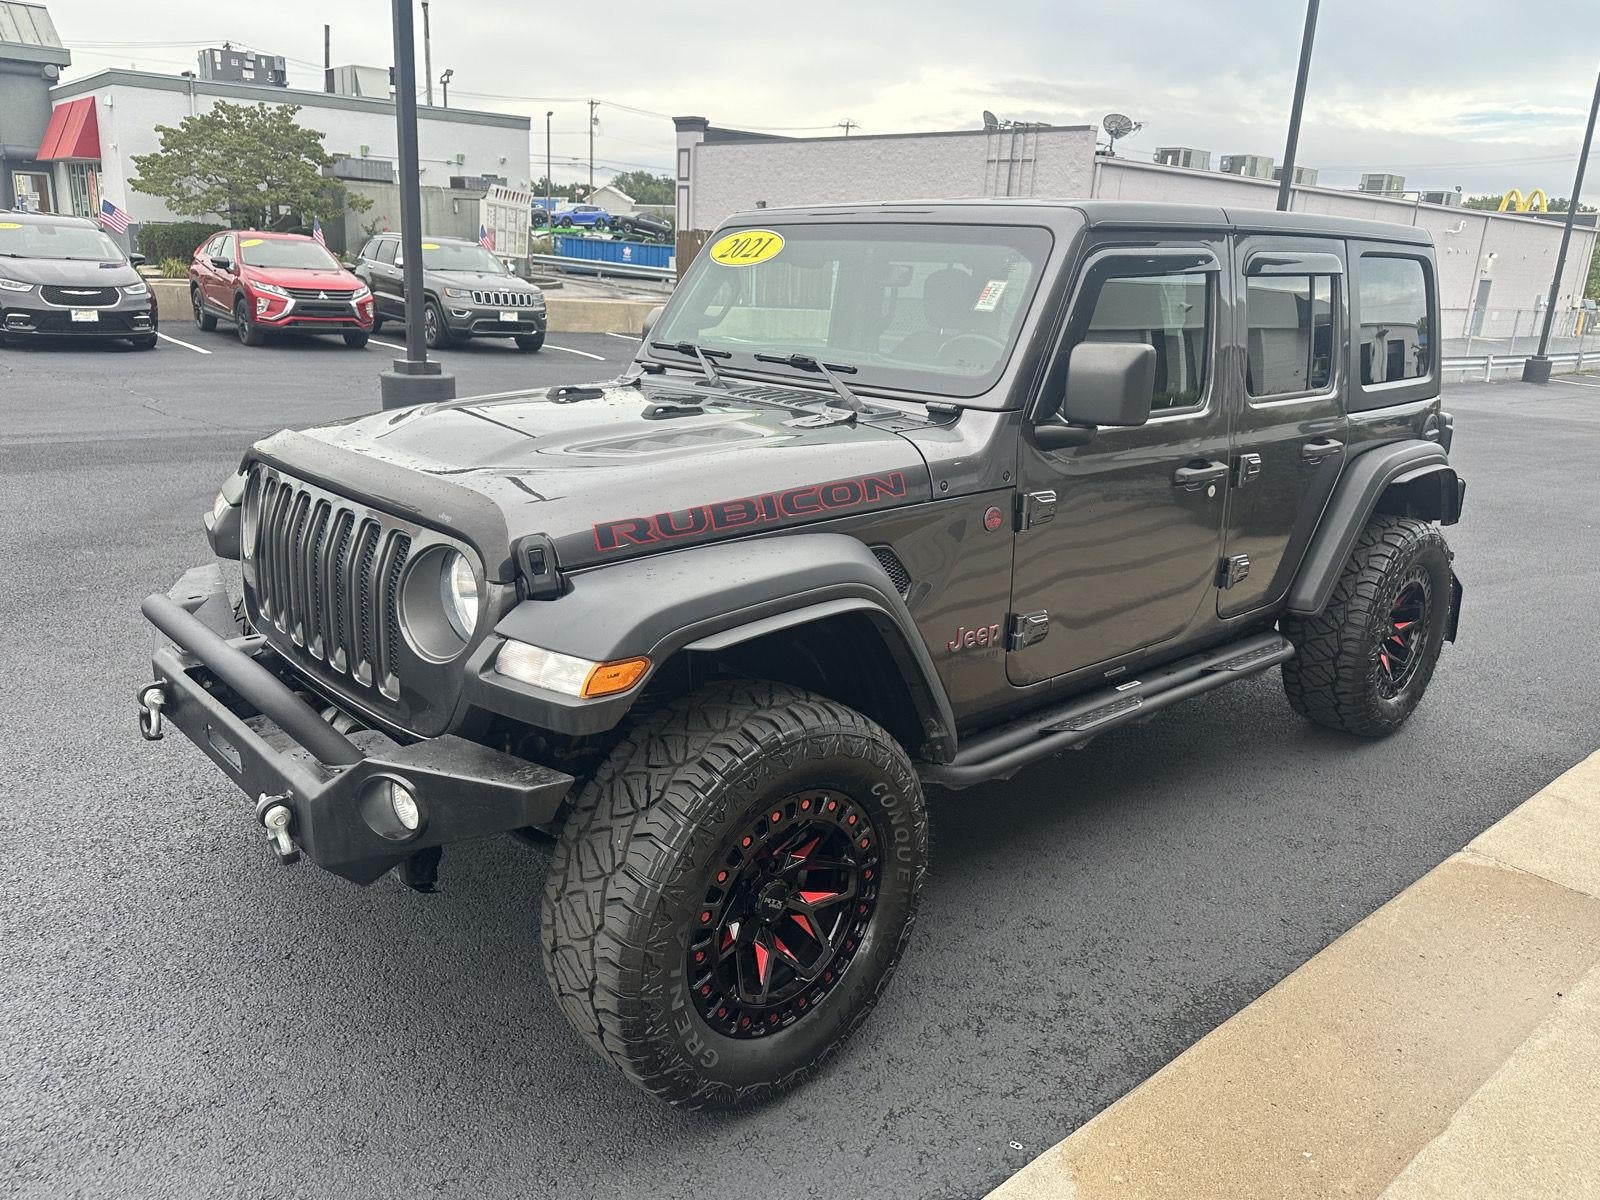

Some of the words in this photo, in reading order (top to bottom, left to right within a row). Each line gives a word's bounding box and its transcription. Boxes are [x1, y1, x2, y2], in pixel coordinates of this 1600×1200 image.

[718, 237, 775, 258] 2021
[592, 472, 907, 551] RUBICON
[946, 624, 1001, 653] Jeep
